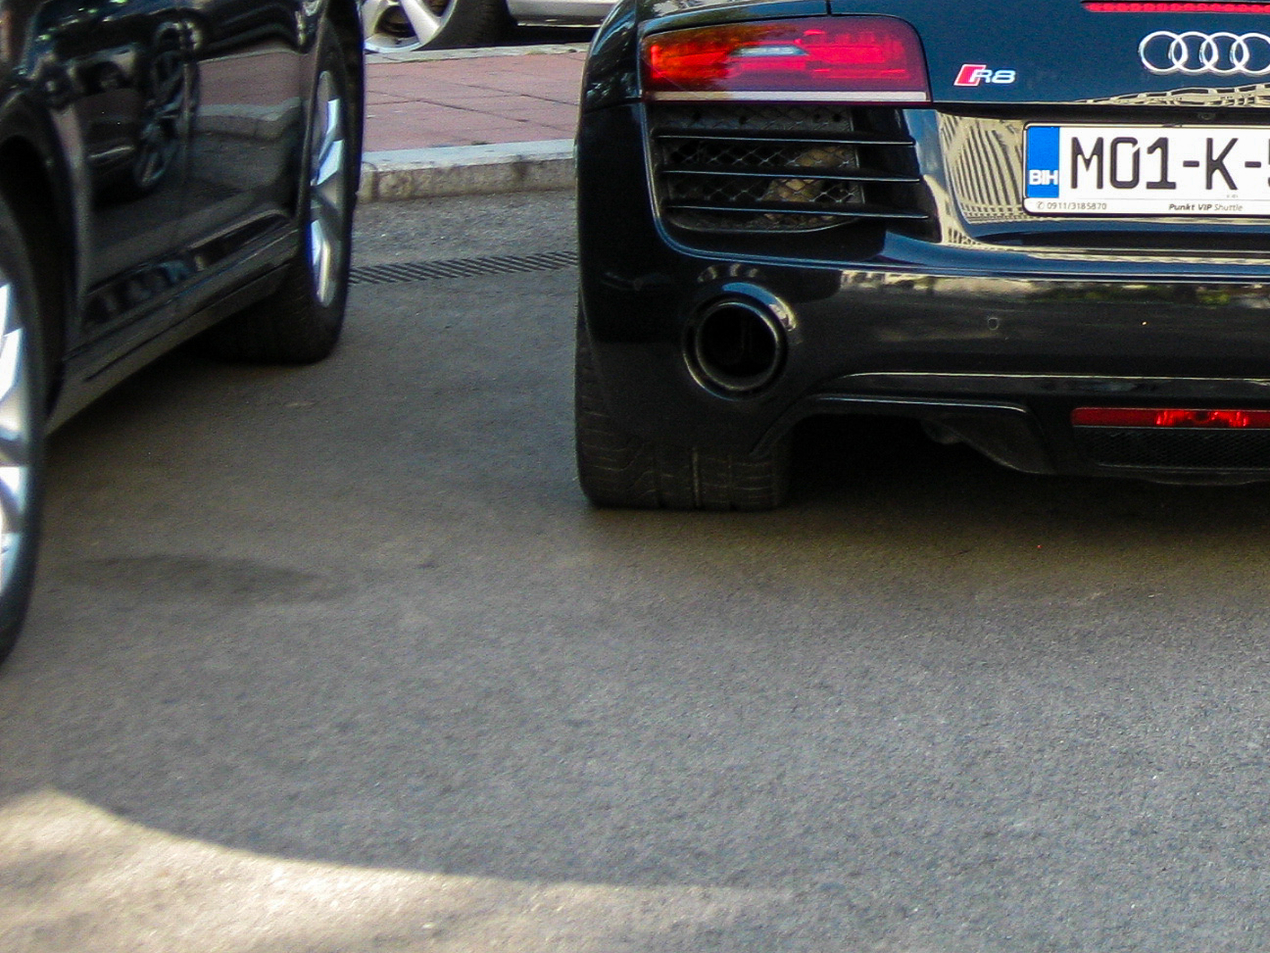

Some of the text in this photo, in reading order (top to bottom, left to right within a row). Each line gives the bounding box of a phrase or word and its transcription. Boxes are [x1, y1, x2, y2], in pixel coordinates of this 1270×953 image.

[969, 69, 1016, 83] R8
[1028, 169, 1058, 185] BIH
[1168, 203, 1195, 211] Punkt
